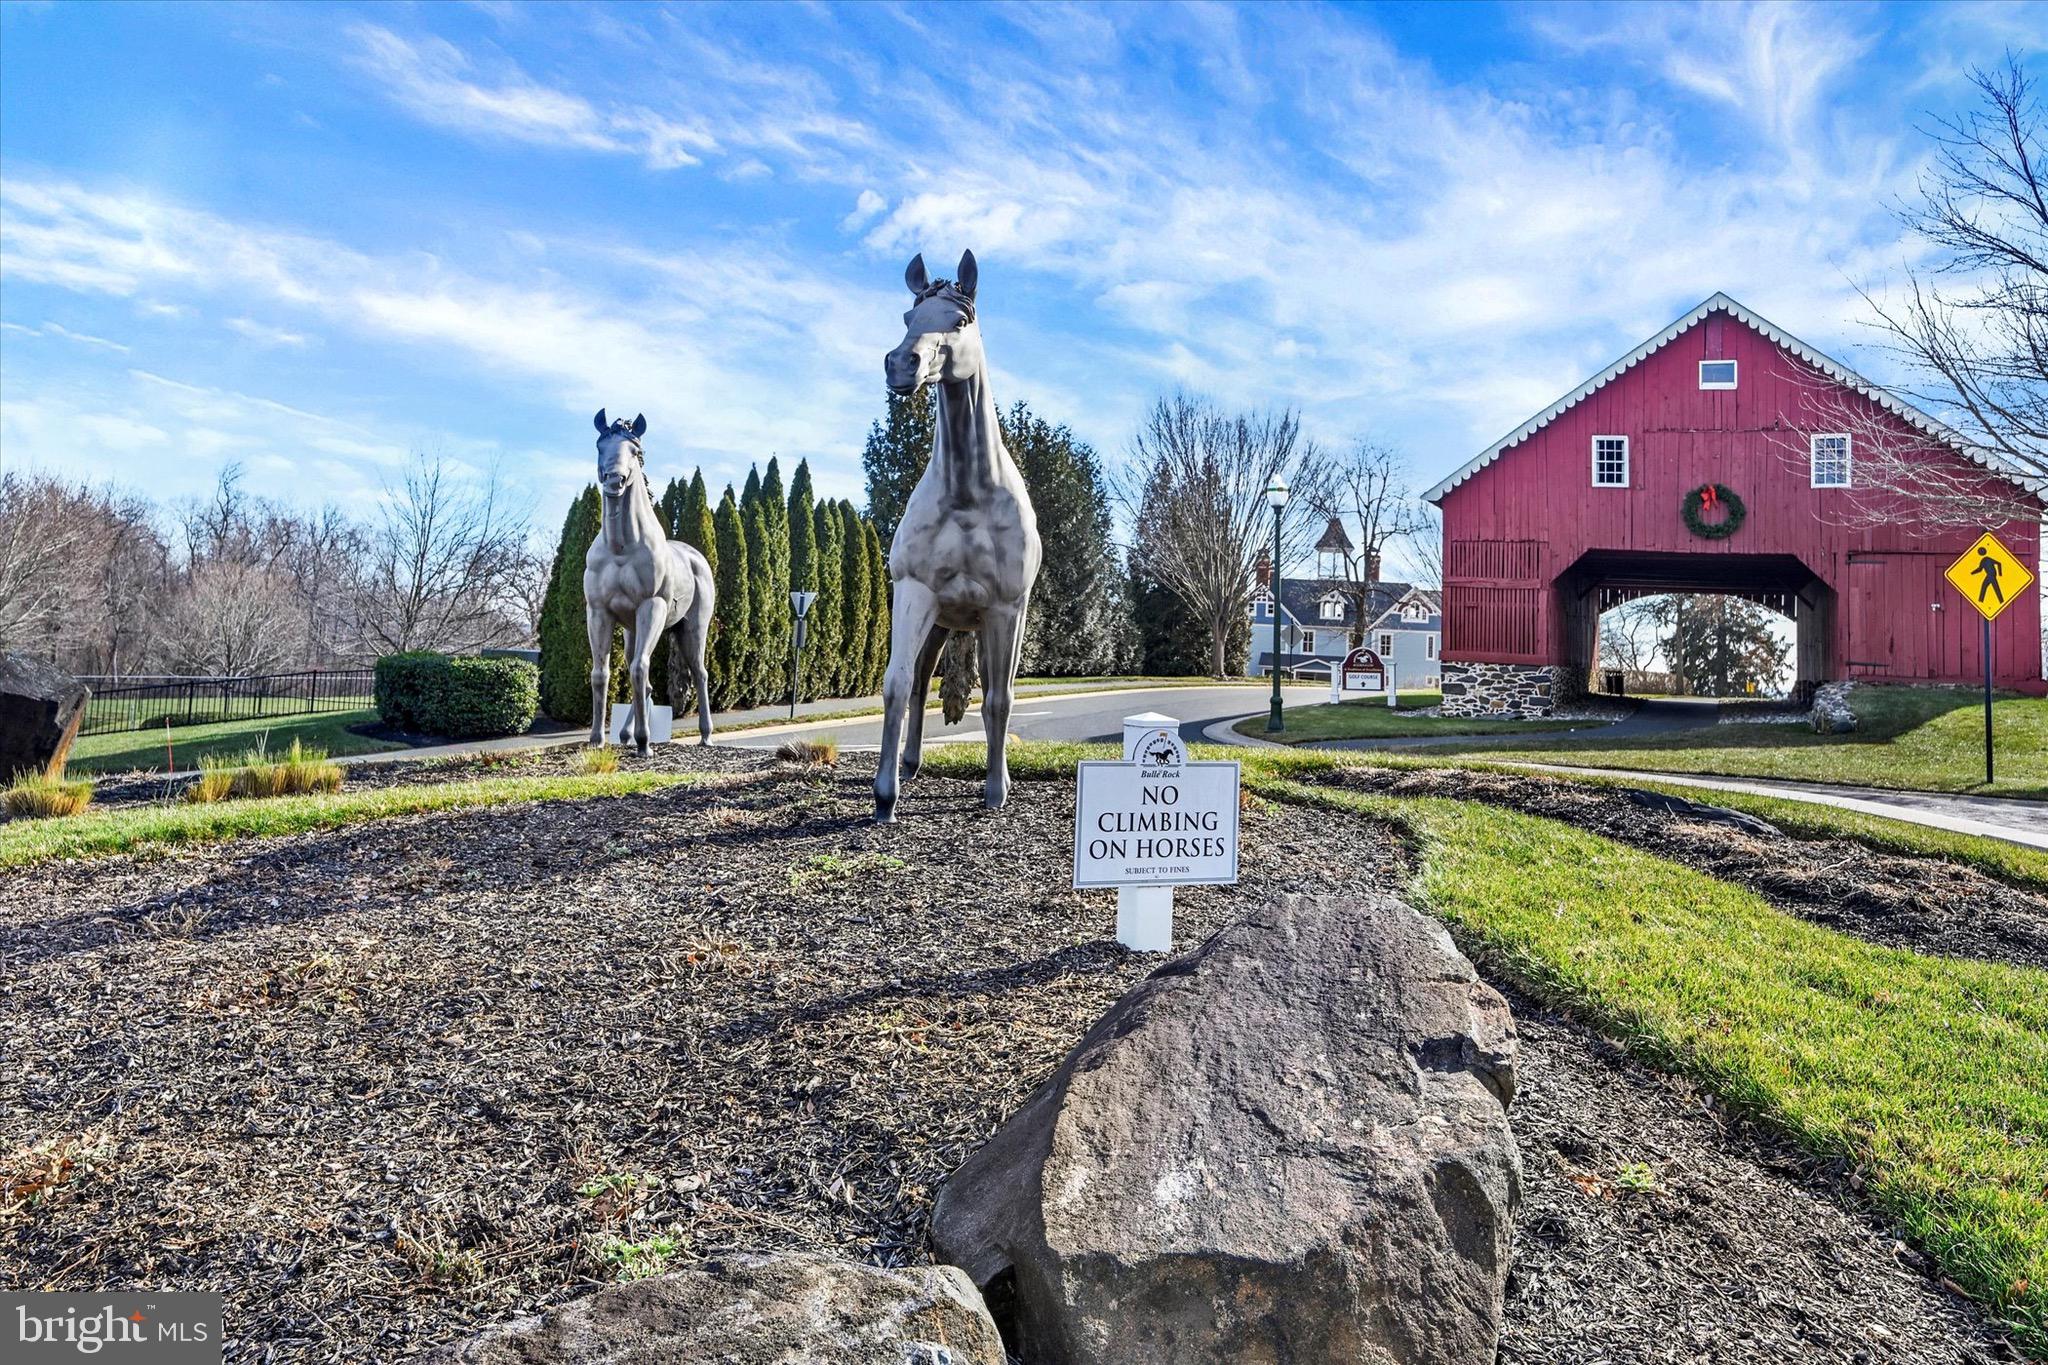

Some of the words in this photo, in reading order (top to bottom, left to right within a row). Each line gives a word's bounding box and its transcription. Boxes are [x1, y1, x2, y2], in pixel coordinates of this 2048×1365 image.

[1141, 770, 1161, 778] Bulle
[1161, 770, 1181, 778] Rock
[1141, 785, 1179, 806] NO
[1098, 811, 1218, 833] CLIMBING
[1089, 839, 1127, 860] ON
[1136, 837, 1225, 859] HORSES
[1124, 867, 1156, 875] SUBJECT
[1169, 865, 1190, 873] FINES
